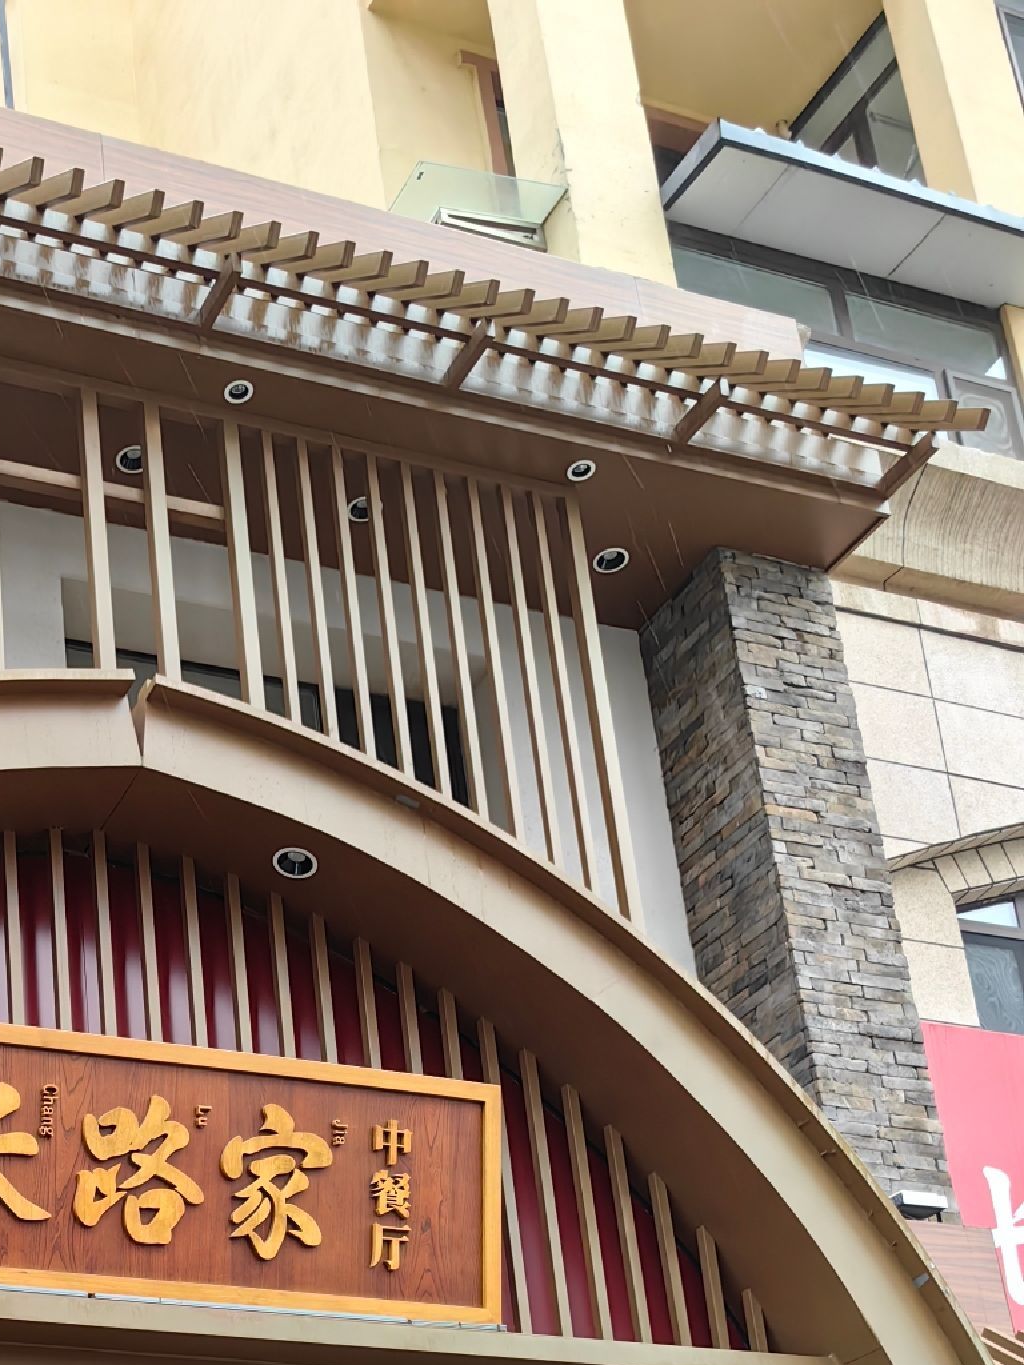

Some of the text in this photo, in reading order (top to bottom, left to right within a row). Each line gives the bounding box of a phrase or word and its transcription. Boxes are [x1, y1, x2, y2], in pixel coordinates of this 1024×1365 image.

[39, 1084, 59, 1137] Chang
[195, 1105, 213, 1128] Lu
[332, 1119, 348, 1145] Jia
[370, 1119, 413, 1271] 中餐厅
